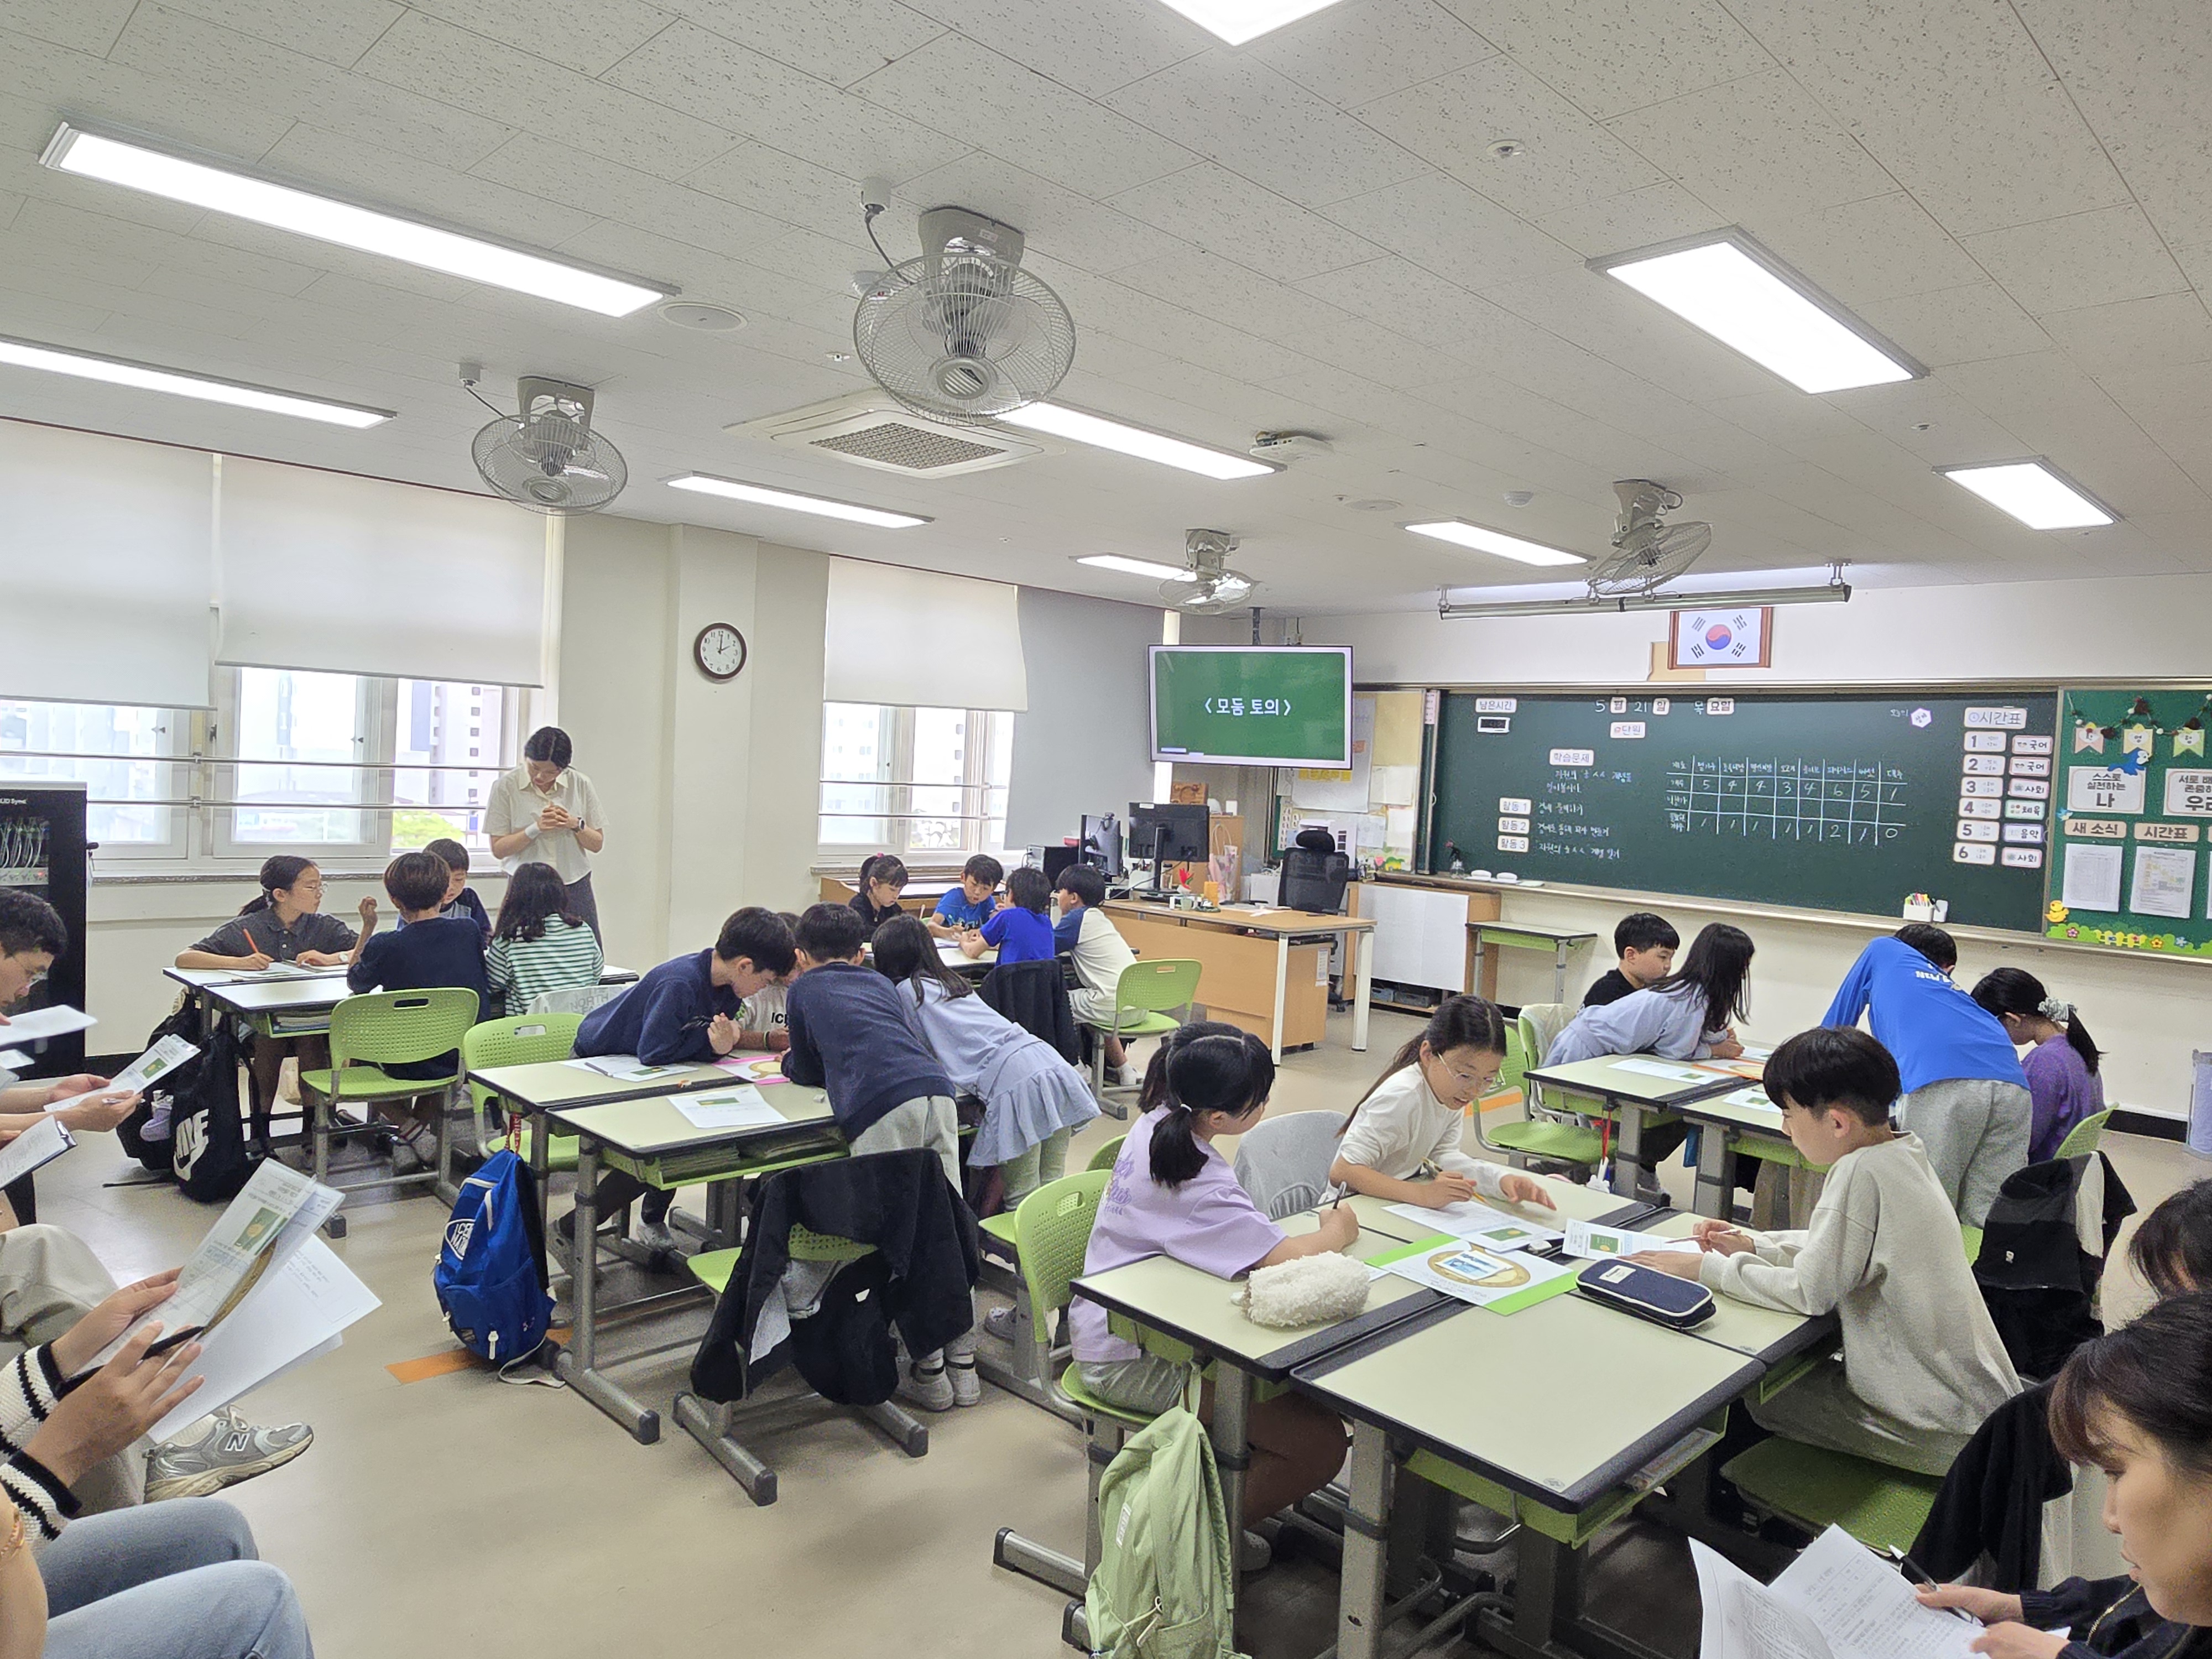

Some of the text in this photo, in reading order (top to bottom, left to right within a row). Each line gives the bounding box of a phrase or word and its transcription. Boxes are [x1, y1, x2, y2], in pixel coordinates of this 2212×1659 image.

[1978, 711, 2022, 725] 시간표
[1622, 724, 1641, 735] 단원
[1971, 735, 1977, 748] 1
[2030, 740, 2047, 750] 국어
[1553, 753, 1590, 763] 학습문제
[1968, 758, 1978, 770] 2
[2027, 761, 2044, 771] 국어
[2092, 773, 2121, 781] 스스로
[2178, 775, 2199, 784] 서로
[1703, 780, 1711, 790] 5
[1782, 781, 1791, 794] 3
[1804, 782, 1817, 795] 4
[1833, 784, 1843, 796] 6
[1860, 784, 1872, 799] 5
[1966, 781, 1976, 793] 3
[2025, 786, 2044, 794] 사회
[2087, 781, 2126, 791] 실천하는
[2096, 792, 2115, 808] 나
[1964, 801, 1974, 814] 4
[2022, 806, 2041, 816] 체육
[1830, 824, 1841, 837] 2
[1962, 824, 1972, 836] 5
[2021, 828, 2039, 839] 음악
[2072, 822, 2118, 836] 새 소식
[2143, 826, 2188, 839] 시간표
[1958, 846, 1968, 858] 6
[2017, 854, 2037, 863] 사회
